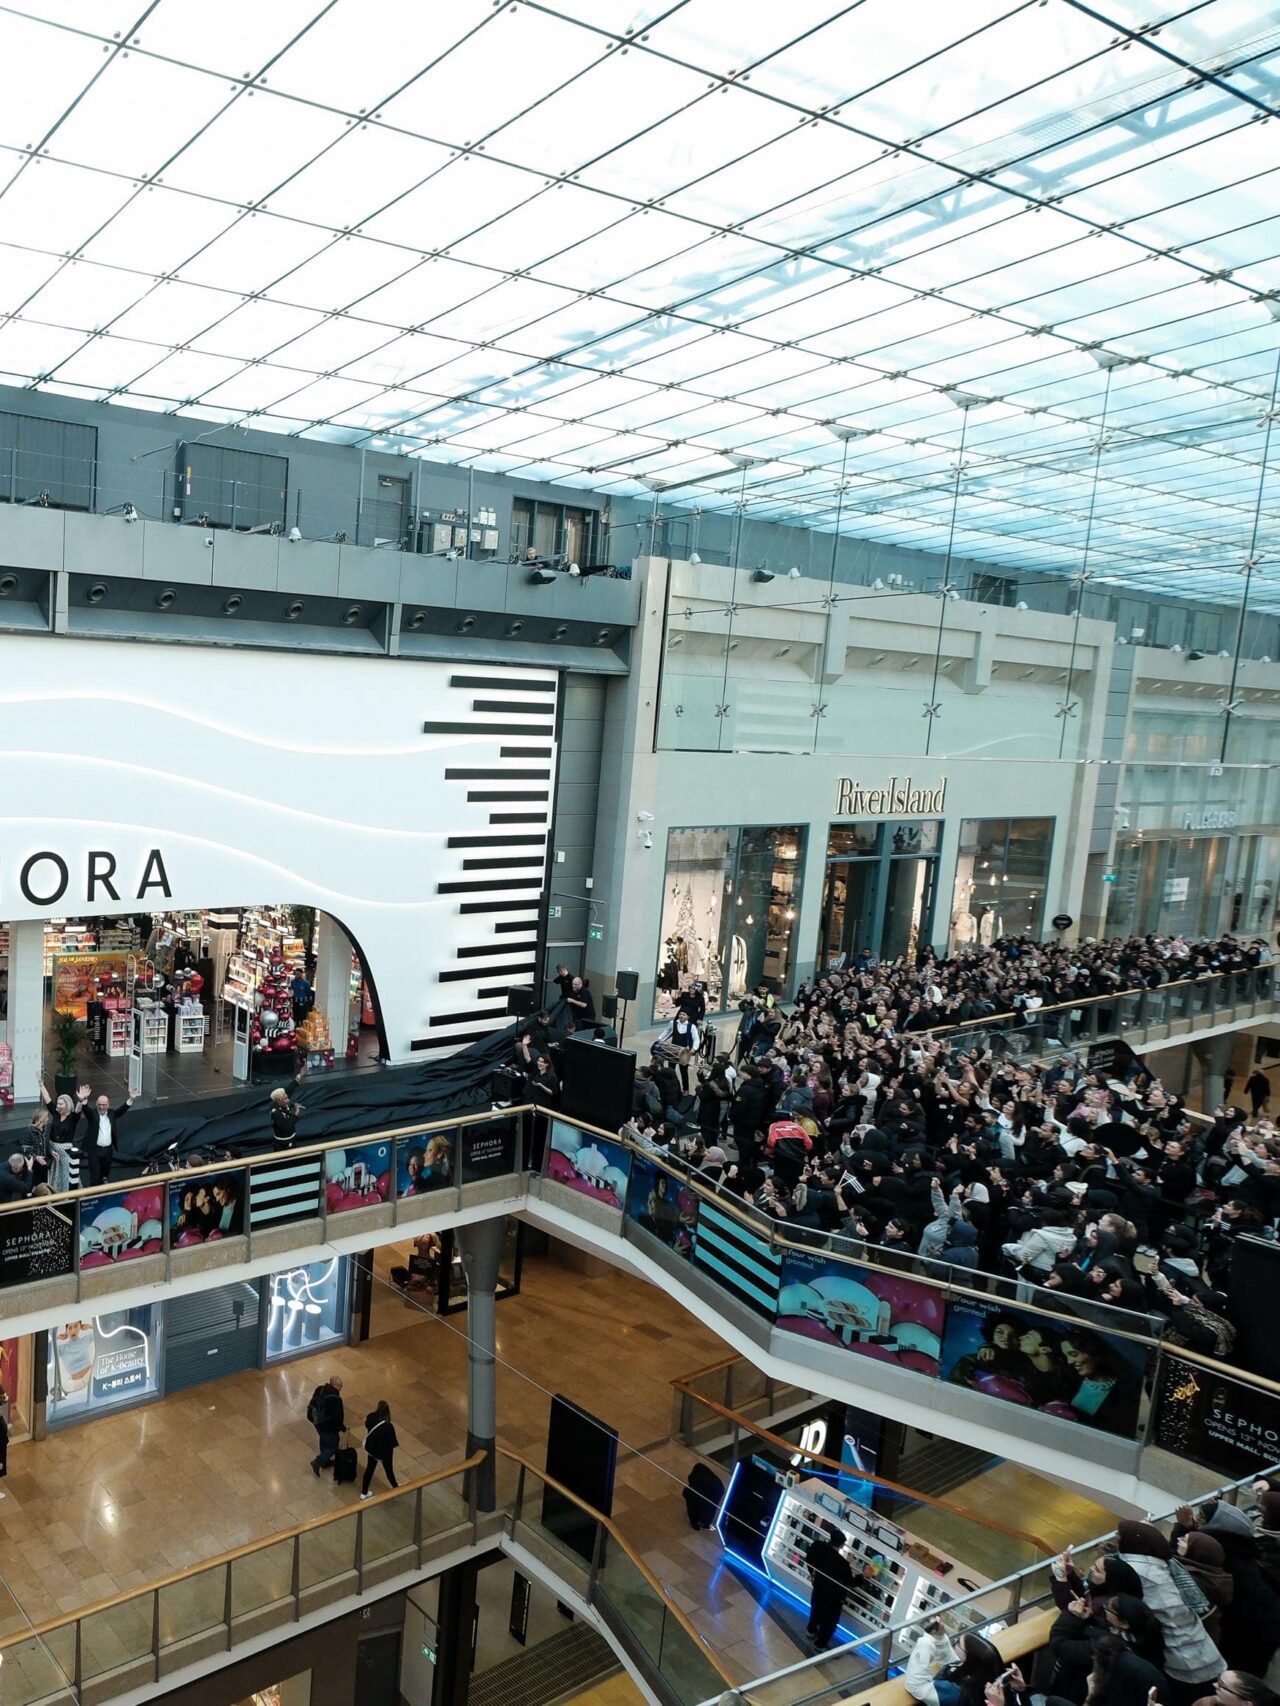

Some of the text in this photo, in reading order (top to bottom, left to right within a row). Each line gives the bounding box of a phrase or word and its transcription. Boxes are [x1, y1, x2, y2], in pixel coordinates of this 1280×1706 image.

[473, 1138, 502, 1150] SEPHORA
[6, 1231, 51, 1247] SEPHORA
[807, 1253, 826, 1265] wish
[979, 1301, 1002, 1314] wish
[1204, 1418, 1237, 1436] OPENS
[1208, 1429, 1235, 1445] UPPER
